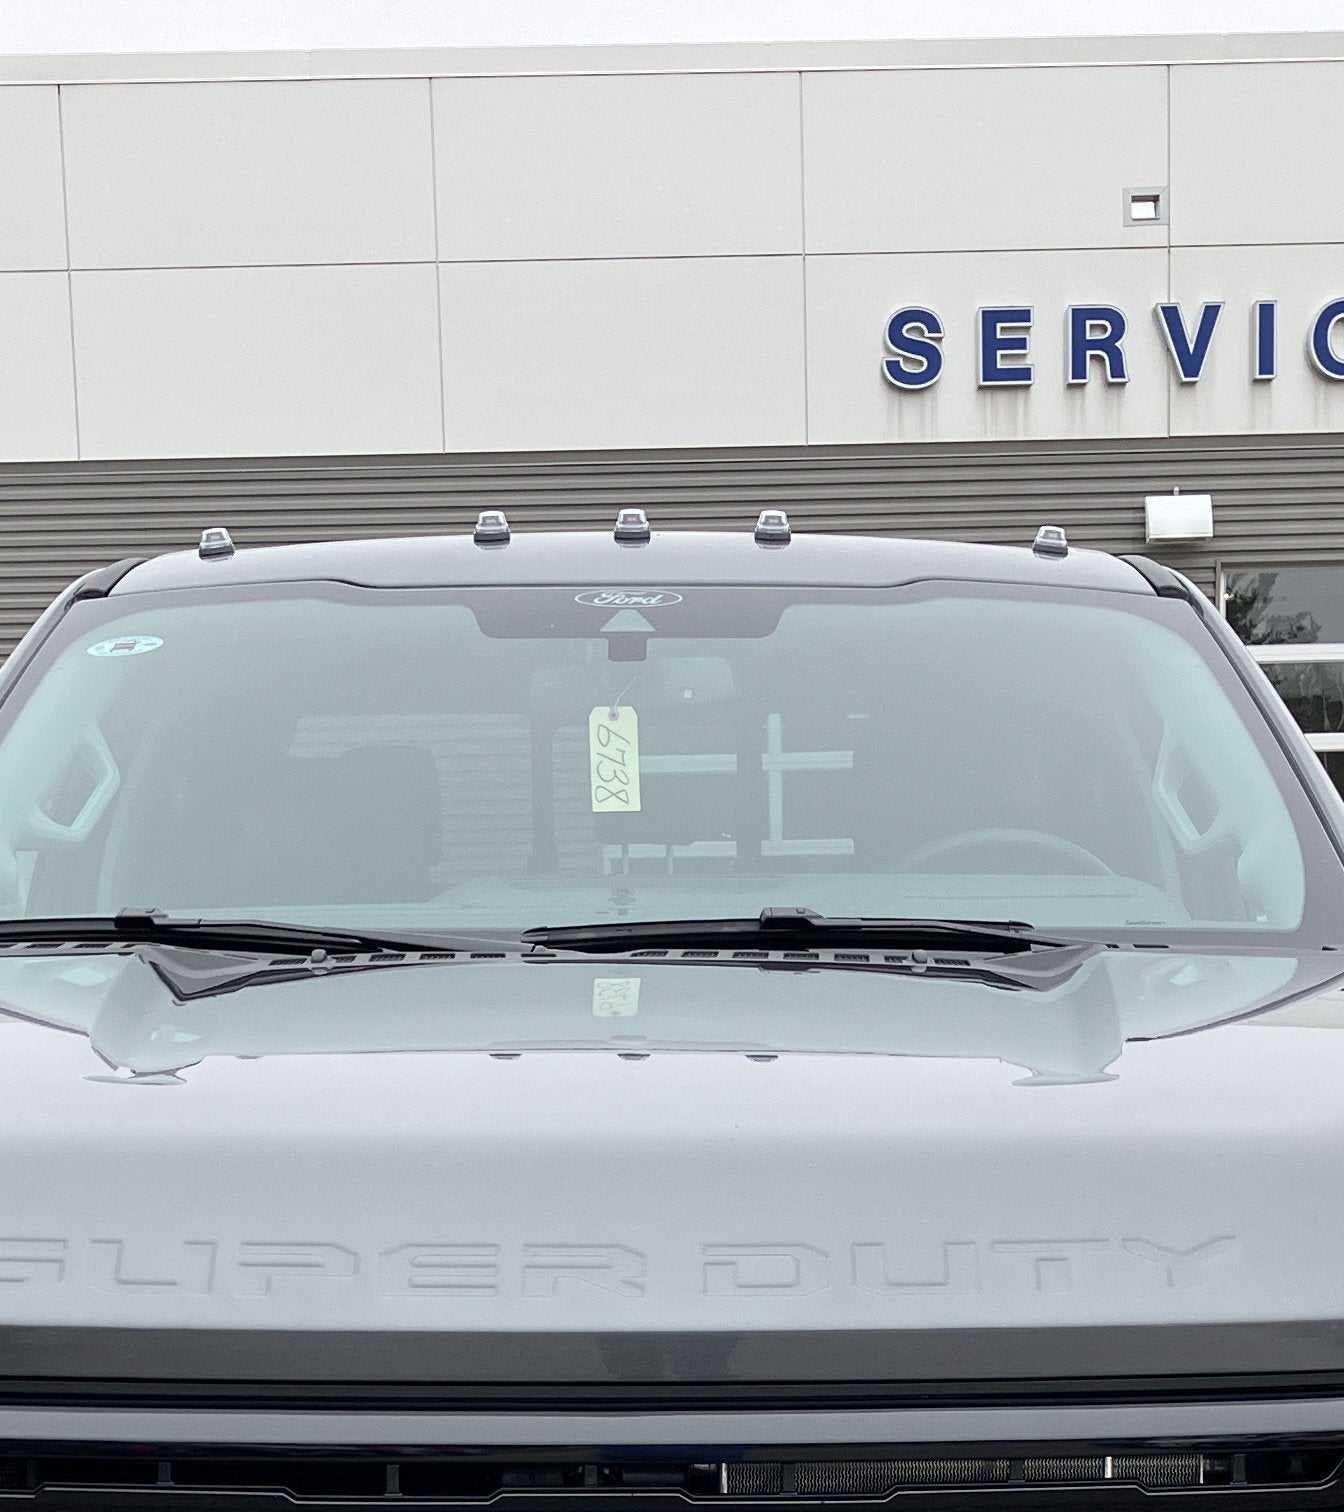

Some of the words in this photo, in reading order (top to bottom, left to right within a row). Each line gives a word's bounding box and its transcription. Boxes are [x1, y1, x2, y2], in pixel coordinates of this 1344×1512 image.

[593, 590, 665, 606] Ford
[594, 723, 632, 805] 6738
[702, 1235, 1237, 1298] DUTY
